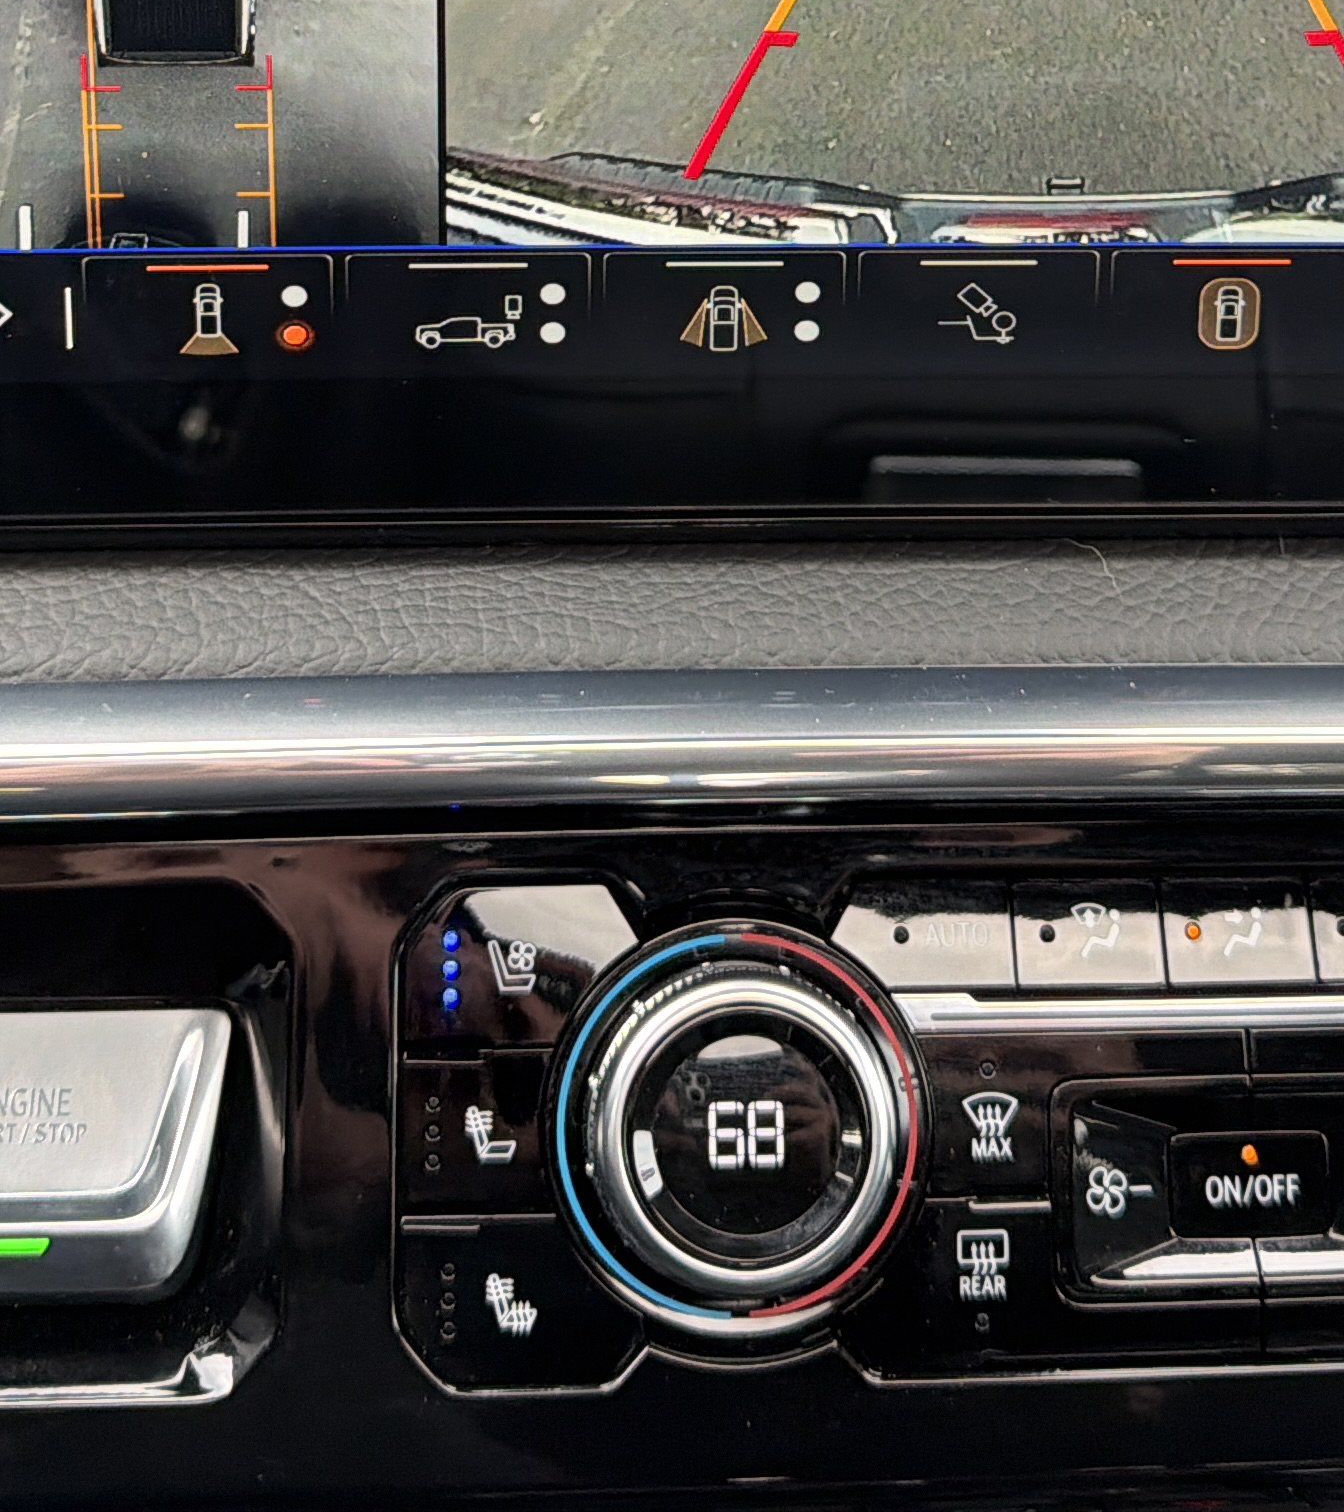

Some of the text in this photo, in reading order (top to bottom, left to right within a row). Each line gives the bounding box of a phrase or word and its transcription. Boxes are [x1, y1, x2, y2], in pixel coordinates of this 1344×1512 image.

[924, 921, 990, 947] AUTO
[707, 1101, 784, 1169] 68
[970, 1138, 1013, 1161] MAX
[1205, 1173, 1301, 1206] ON/OFF
[959, 1276, 1007, 1300] REAR
